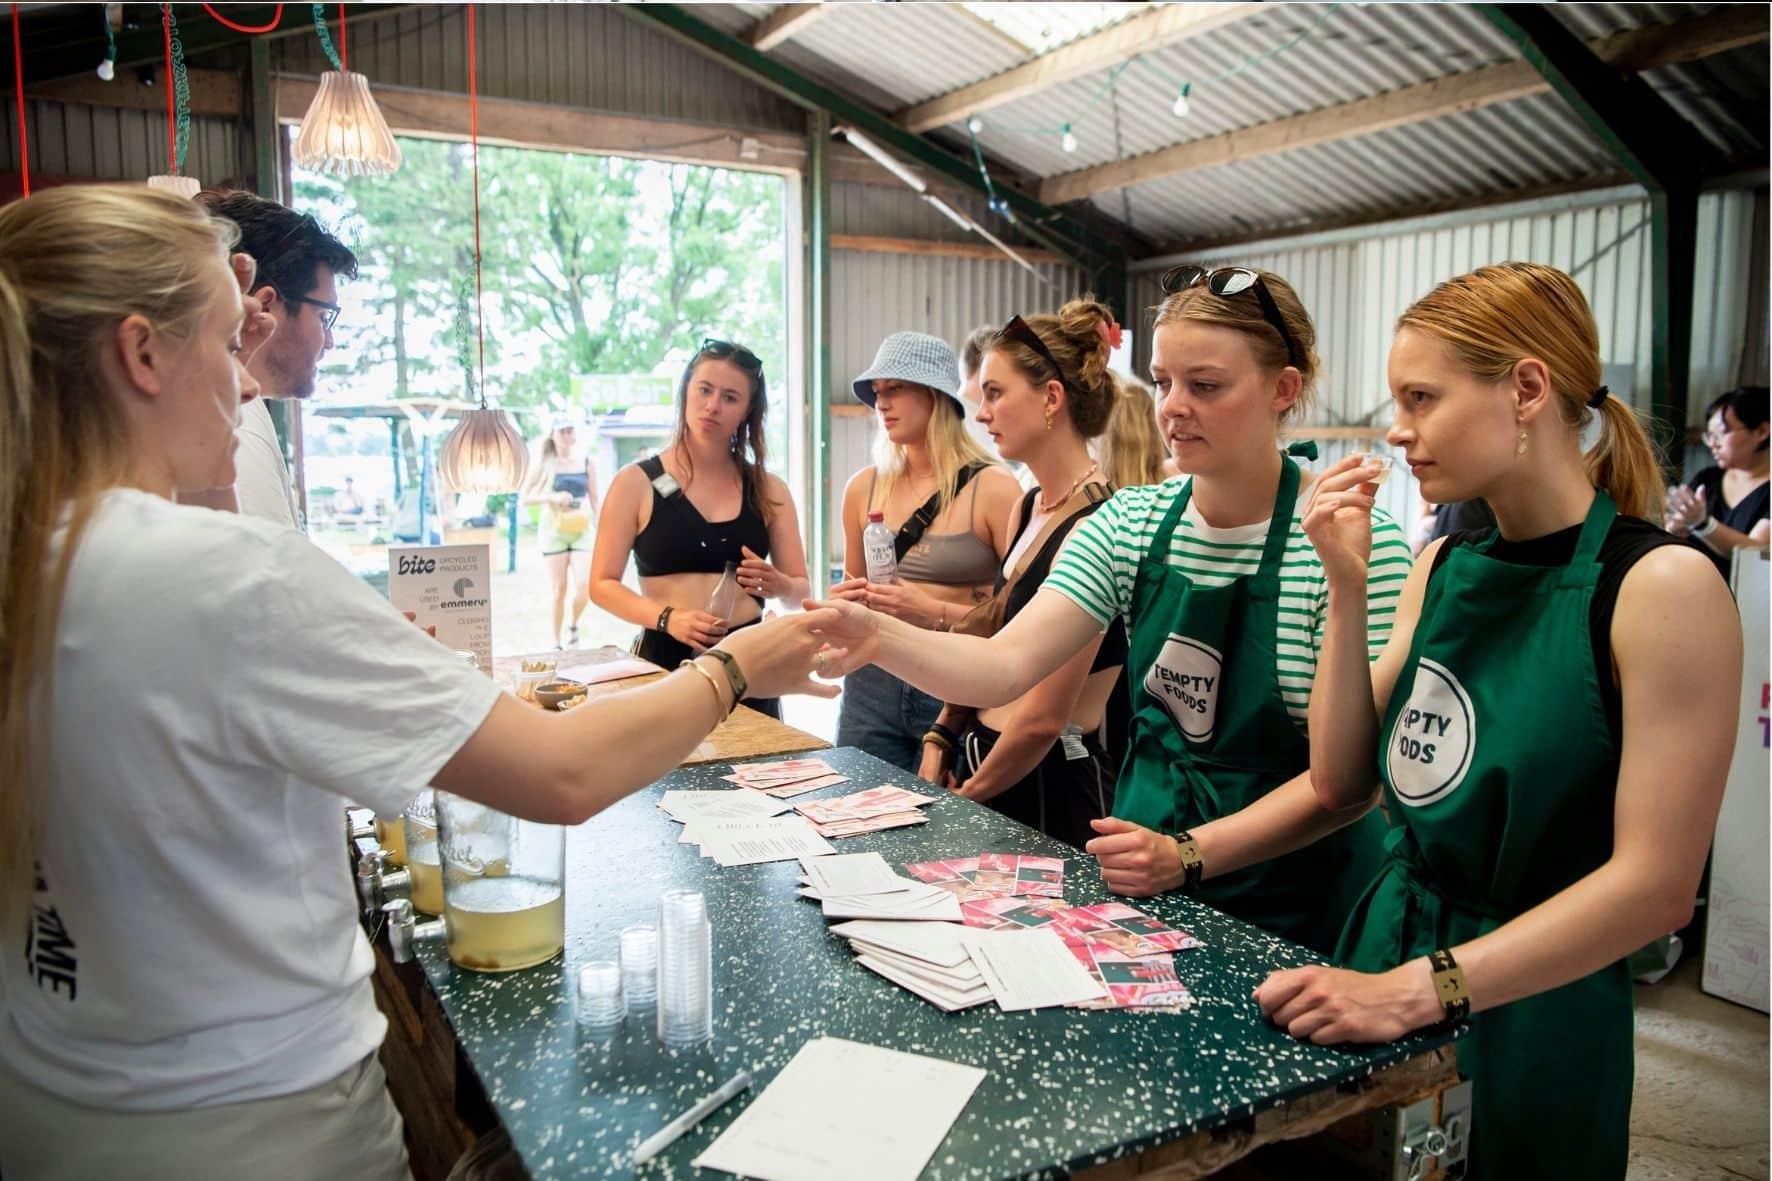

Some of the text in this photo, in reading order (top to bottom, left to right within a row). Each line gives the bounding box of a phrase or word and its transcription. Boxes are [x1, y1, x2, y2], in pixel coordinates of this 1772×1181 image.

[398, 554, 436, 575] bite
[1154, 664, 1215, 692] TEMPTY
[1404, 708, 1451, 737] PTY
[1399, 735, 1437, 764] ODS
